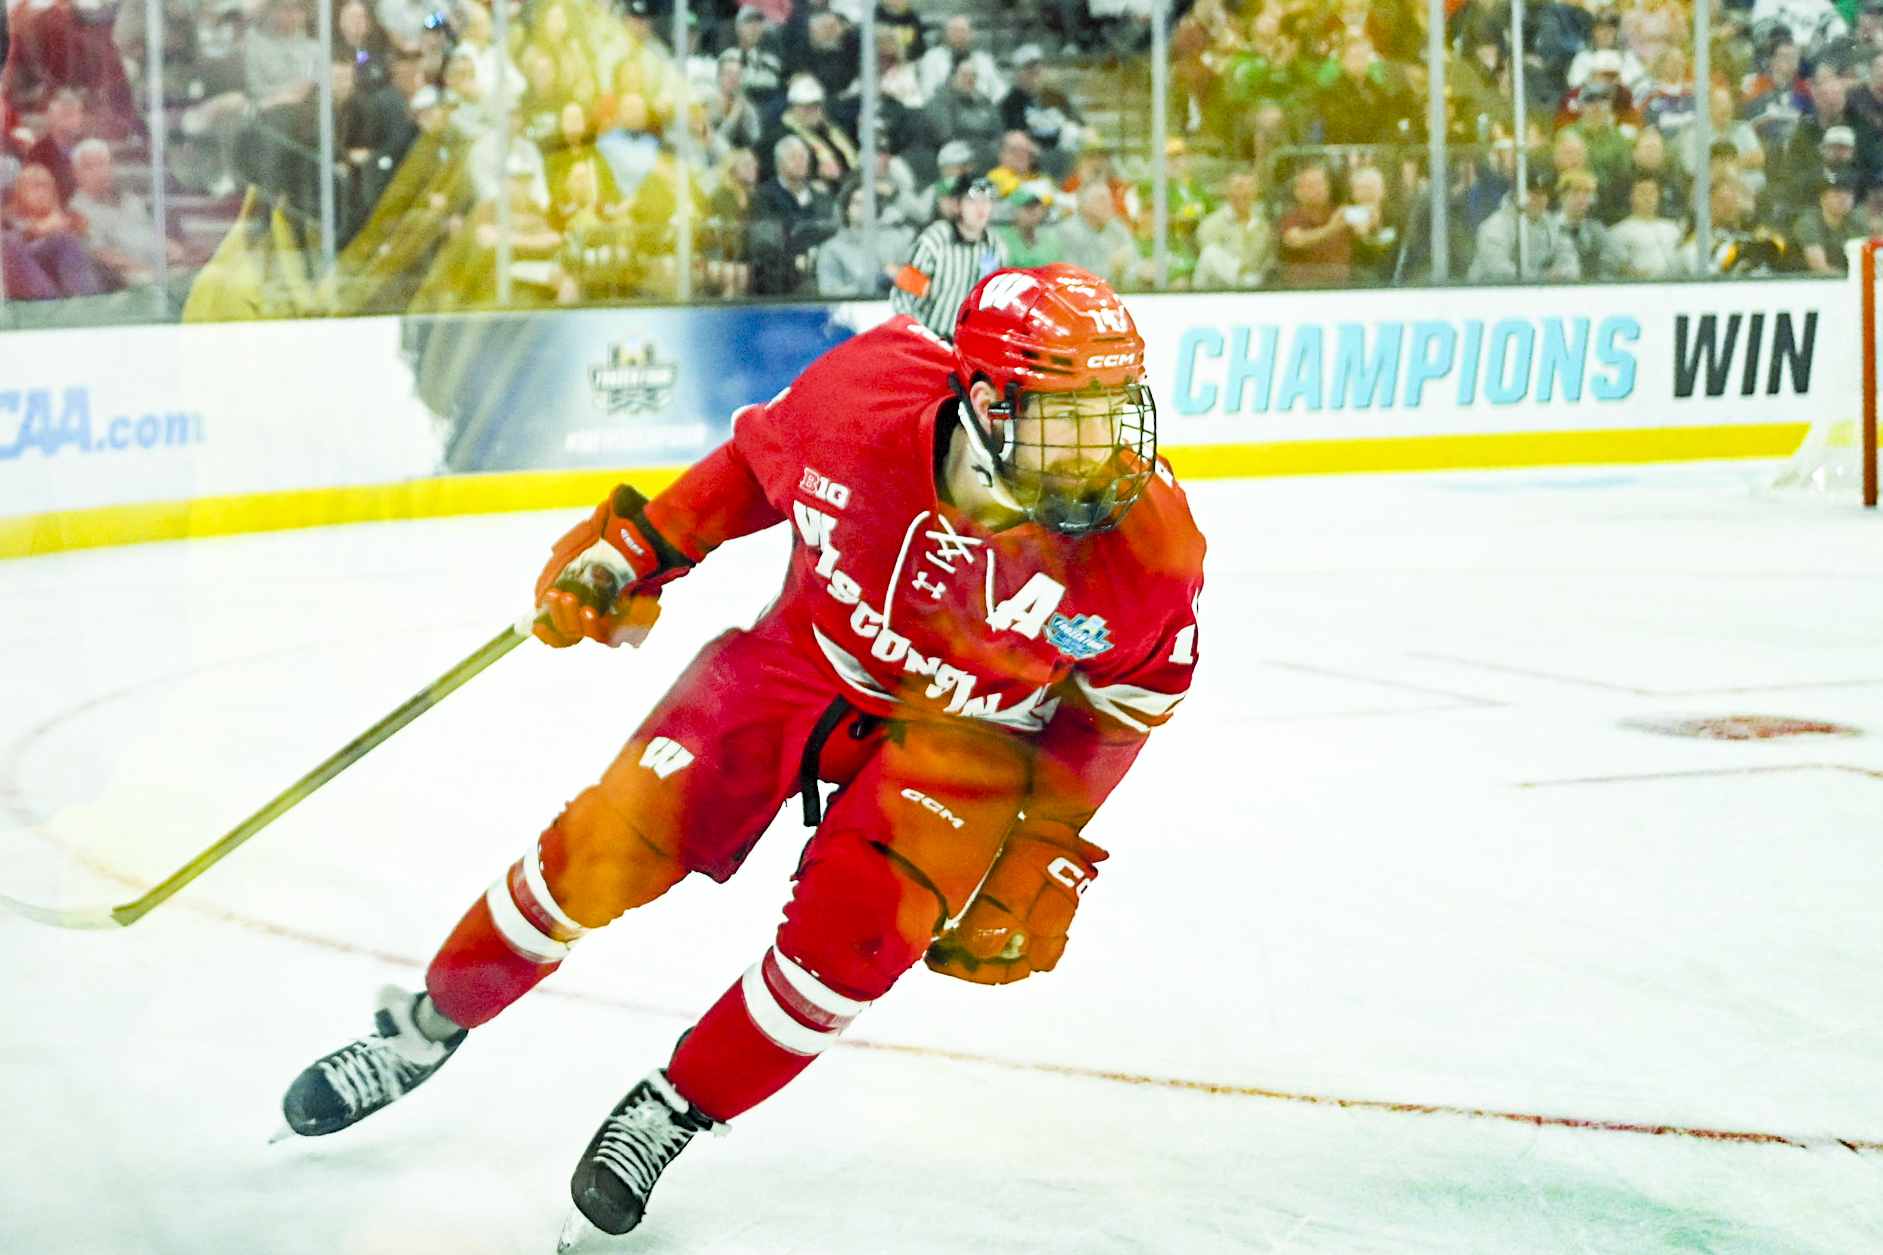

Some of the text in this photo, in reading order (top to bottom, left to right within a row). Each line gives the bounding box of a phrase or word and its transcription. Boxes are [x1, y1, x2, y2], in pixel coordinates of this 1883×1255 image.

[1087, 352, 1135, 369] CCM
[1171, 310, 1819, 415] CHAMPIONS WIN
[985, 572, 1066, 640] A
[900, 788, 965, 829] CCM
